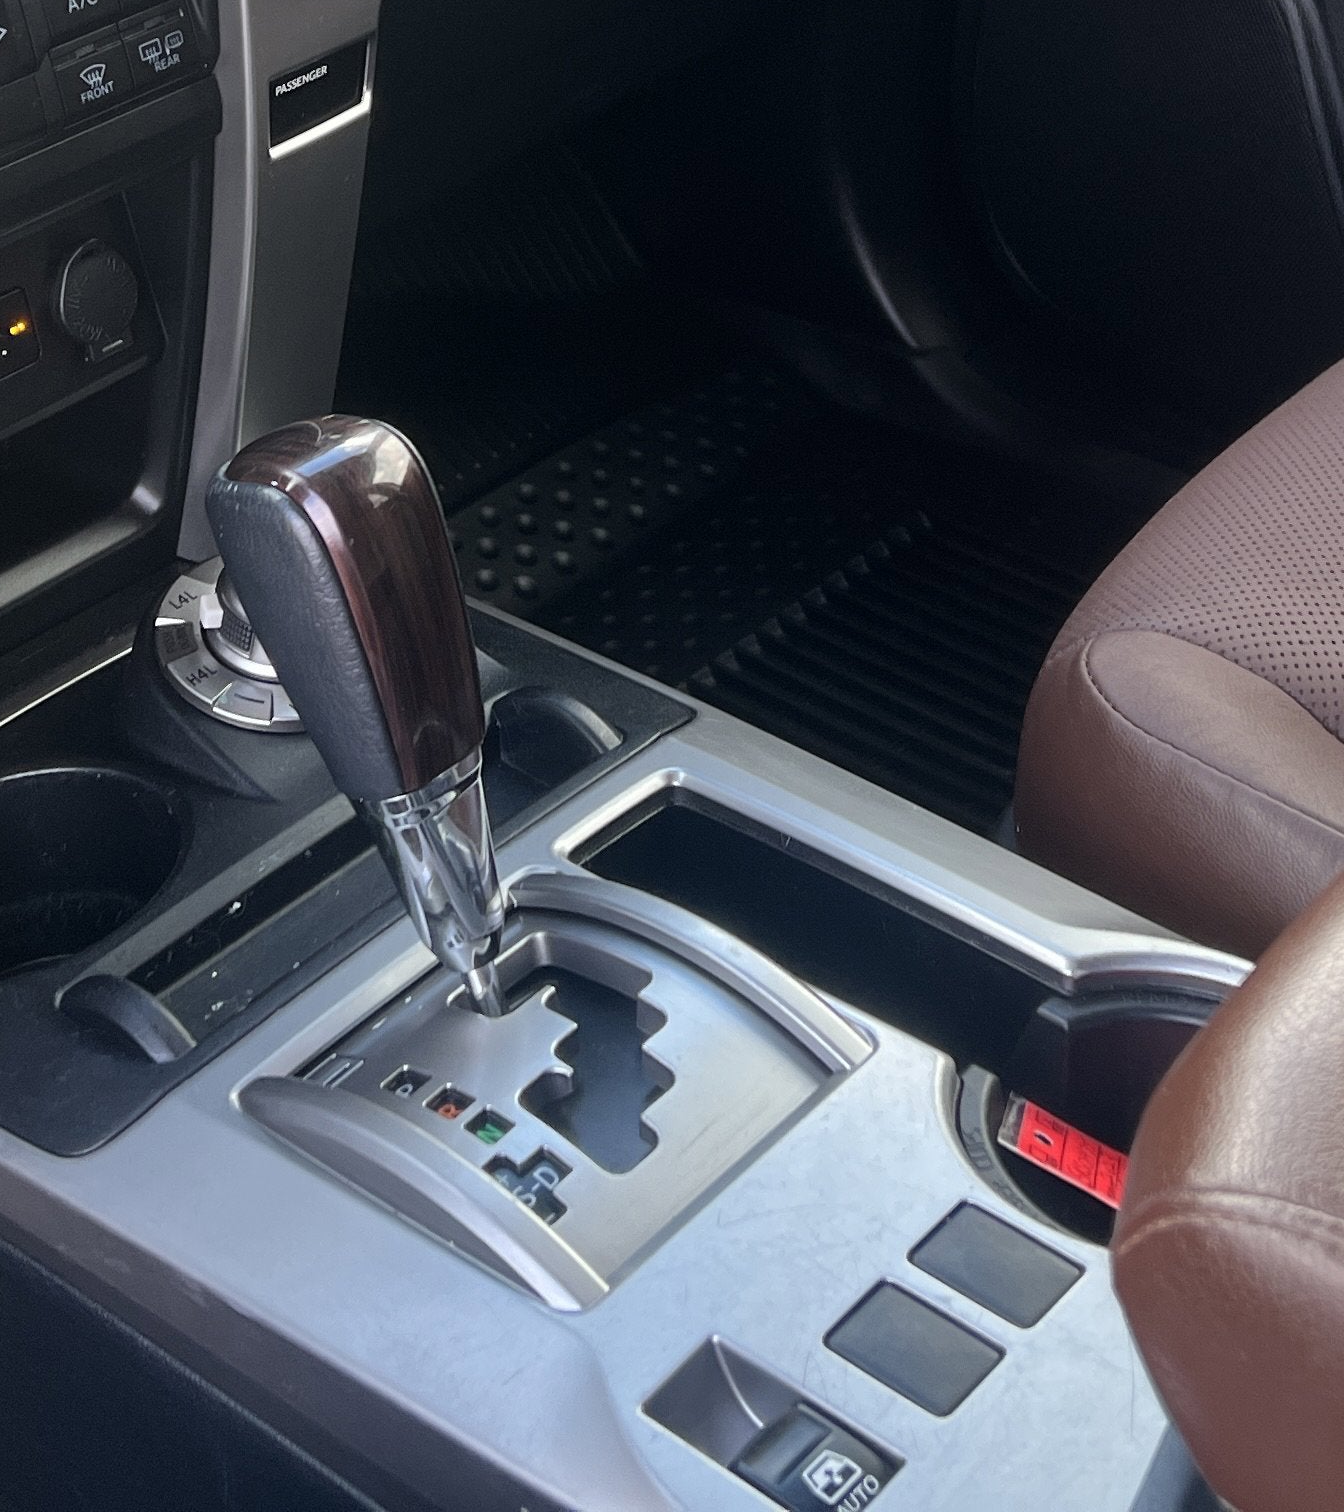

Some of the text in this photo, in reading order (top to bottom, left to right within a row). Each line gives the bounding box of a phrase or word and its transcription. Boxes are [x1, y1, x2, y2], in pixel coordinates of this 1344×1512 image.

[154, 53, 180, 73] REAR
[274, 65, 328, 96] PASSENGER
[81, 81, 114, 103] FRONT
[169, 591, 197, 609] L4L
[186, 665, 218, 686] H4L
